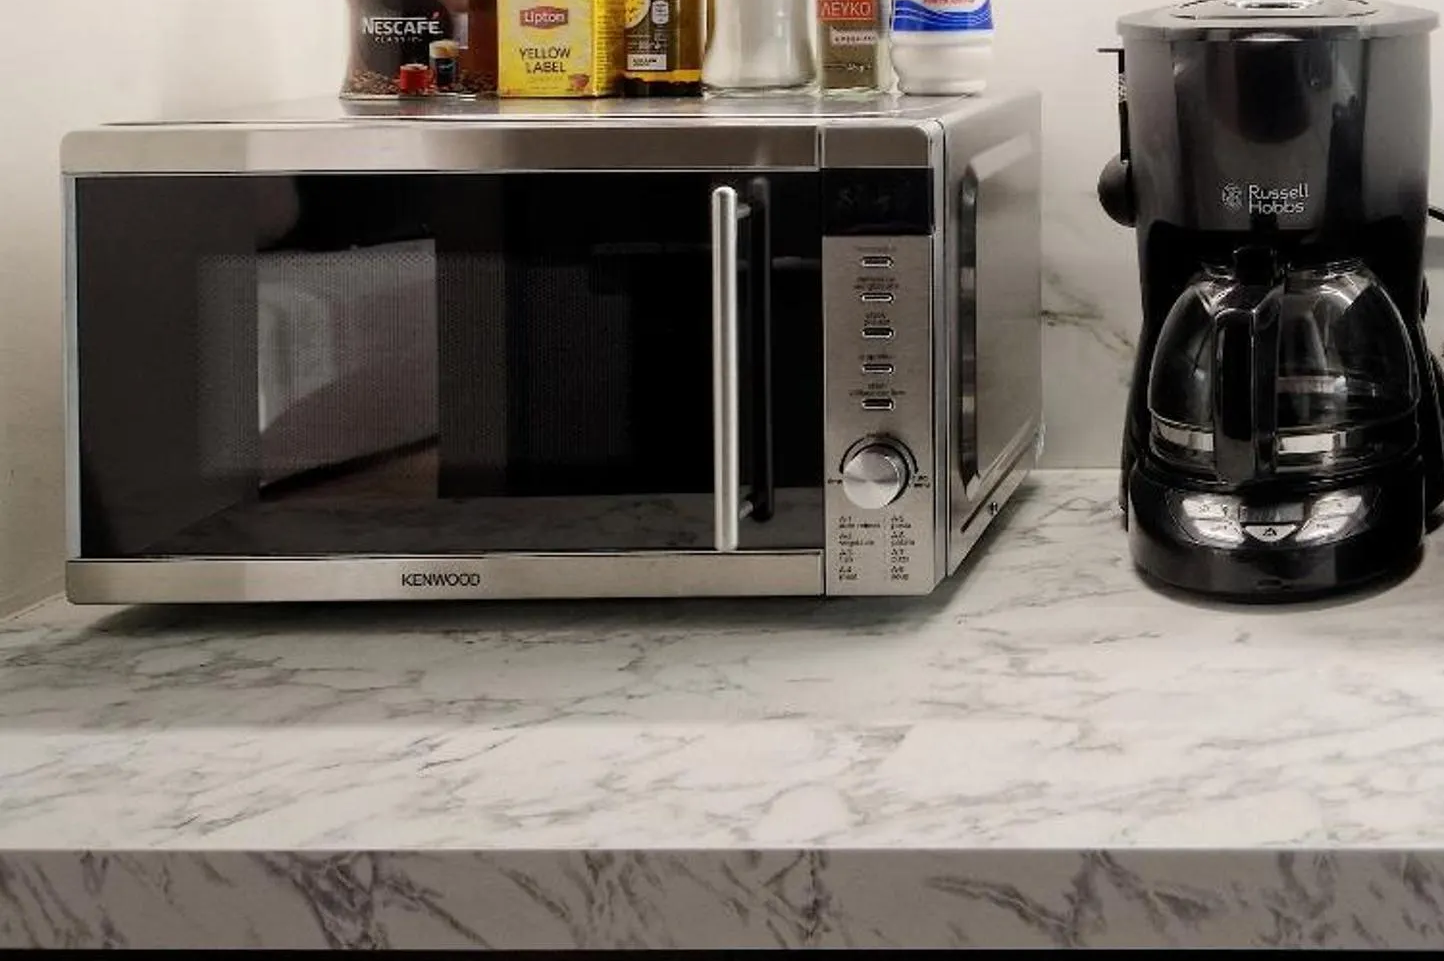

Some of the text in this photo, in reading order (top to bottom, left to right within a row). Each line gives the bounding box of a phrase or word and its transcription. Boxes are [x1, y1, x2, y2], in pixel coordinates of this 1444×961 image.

[821, 1, 872, 17] ΛΕΥΚΟ
[524, 11, 566, 26] Lipton
[519, 45, 571, 60] YELLOW
[525, 60, 567, 74] LABEL
[1248, 183, 1309, 200] Russell
[1248, 199, 1305, 214] Hobbs
[401, 573, 481, 587] KENWOOD
